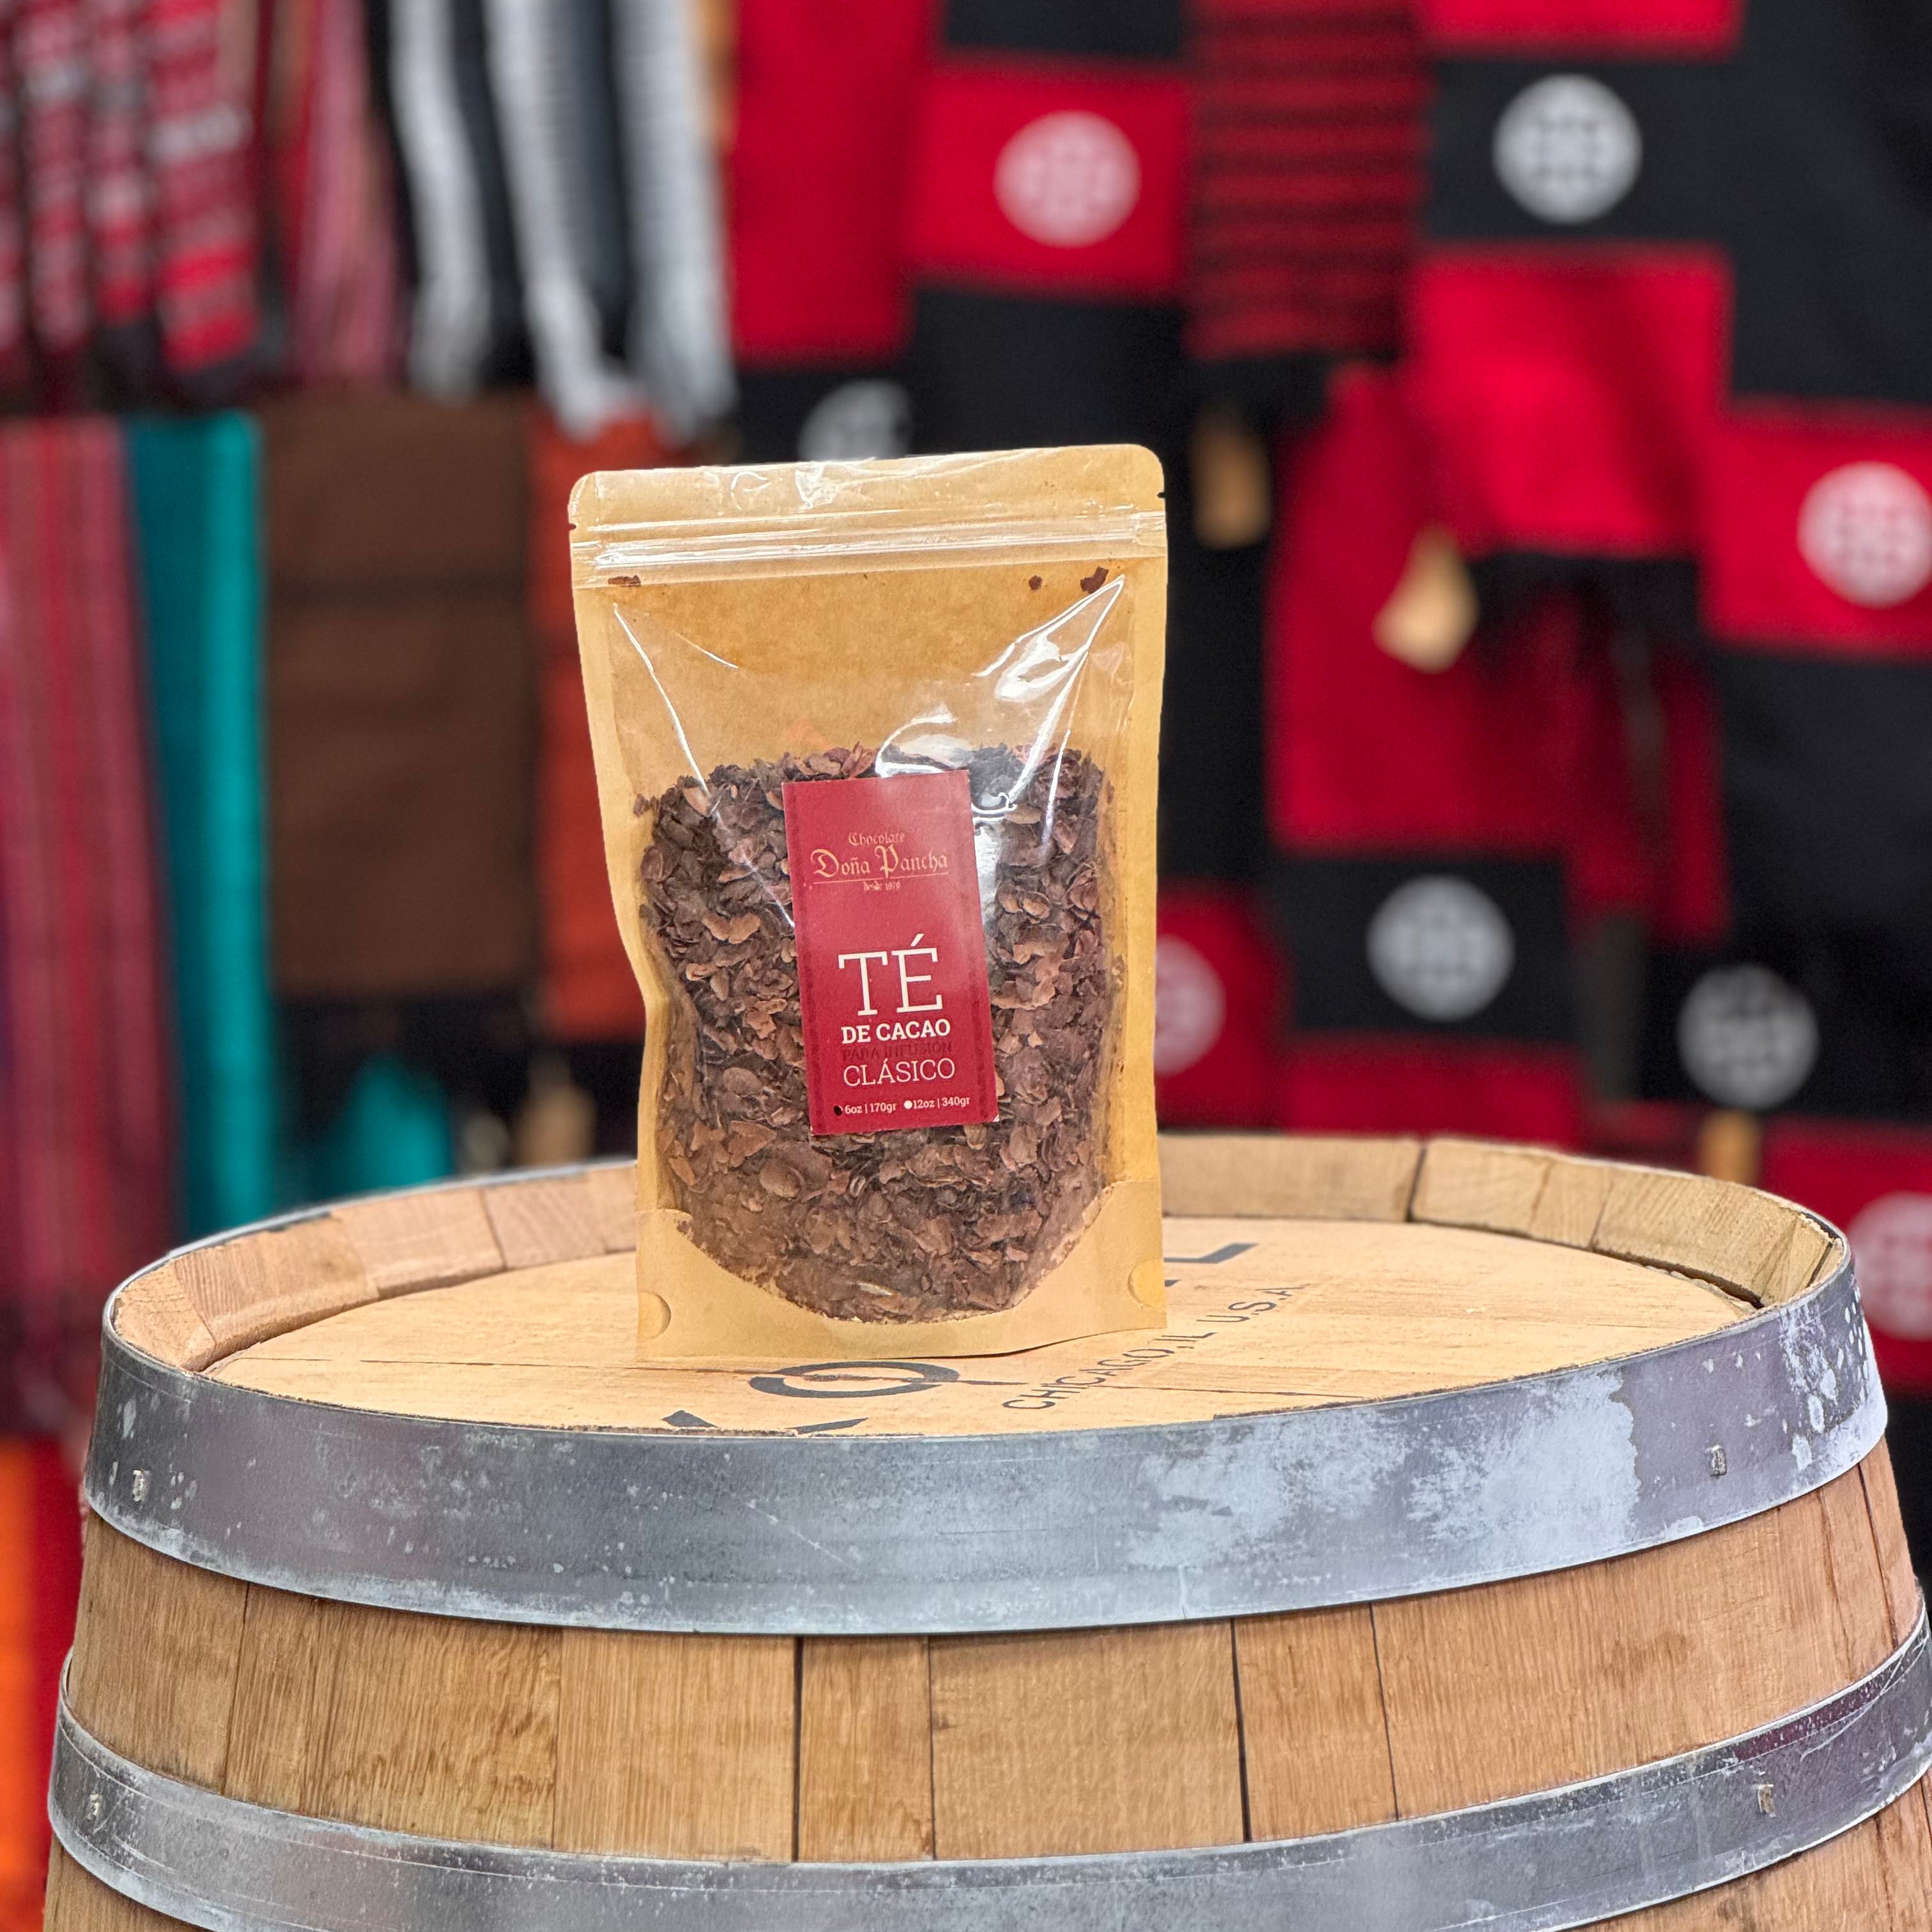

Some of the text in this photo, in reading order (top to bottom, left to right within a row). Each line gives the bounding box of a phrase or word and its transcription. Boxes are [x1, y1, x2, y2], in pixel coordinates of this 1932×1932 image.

[848, 832, 905, 846] Chocolate
[810, 845, 947, 879] Doña Pancha
[838, 933, 943, 1016] TÉ
[841, 1018, 951, 1044] DE CACAO
[843, 1058, 955, 1087] CLÁSICO
[845, 1105, 862, 1115] 6oz
[870, 1102, 896, 1116] 170gr
[913, 1099, 935, 1109] 12oz
[942, 1096, 970, 1108] 340gr
